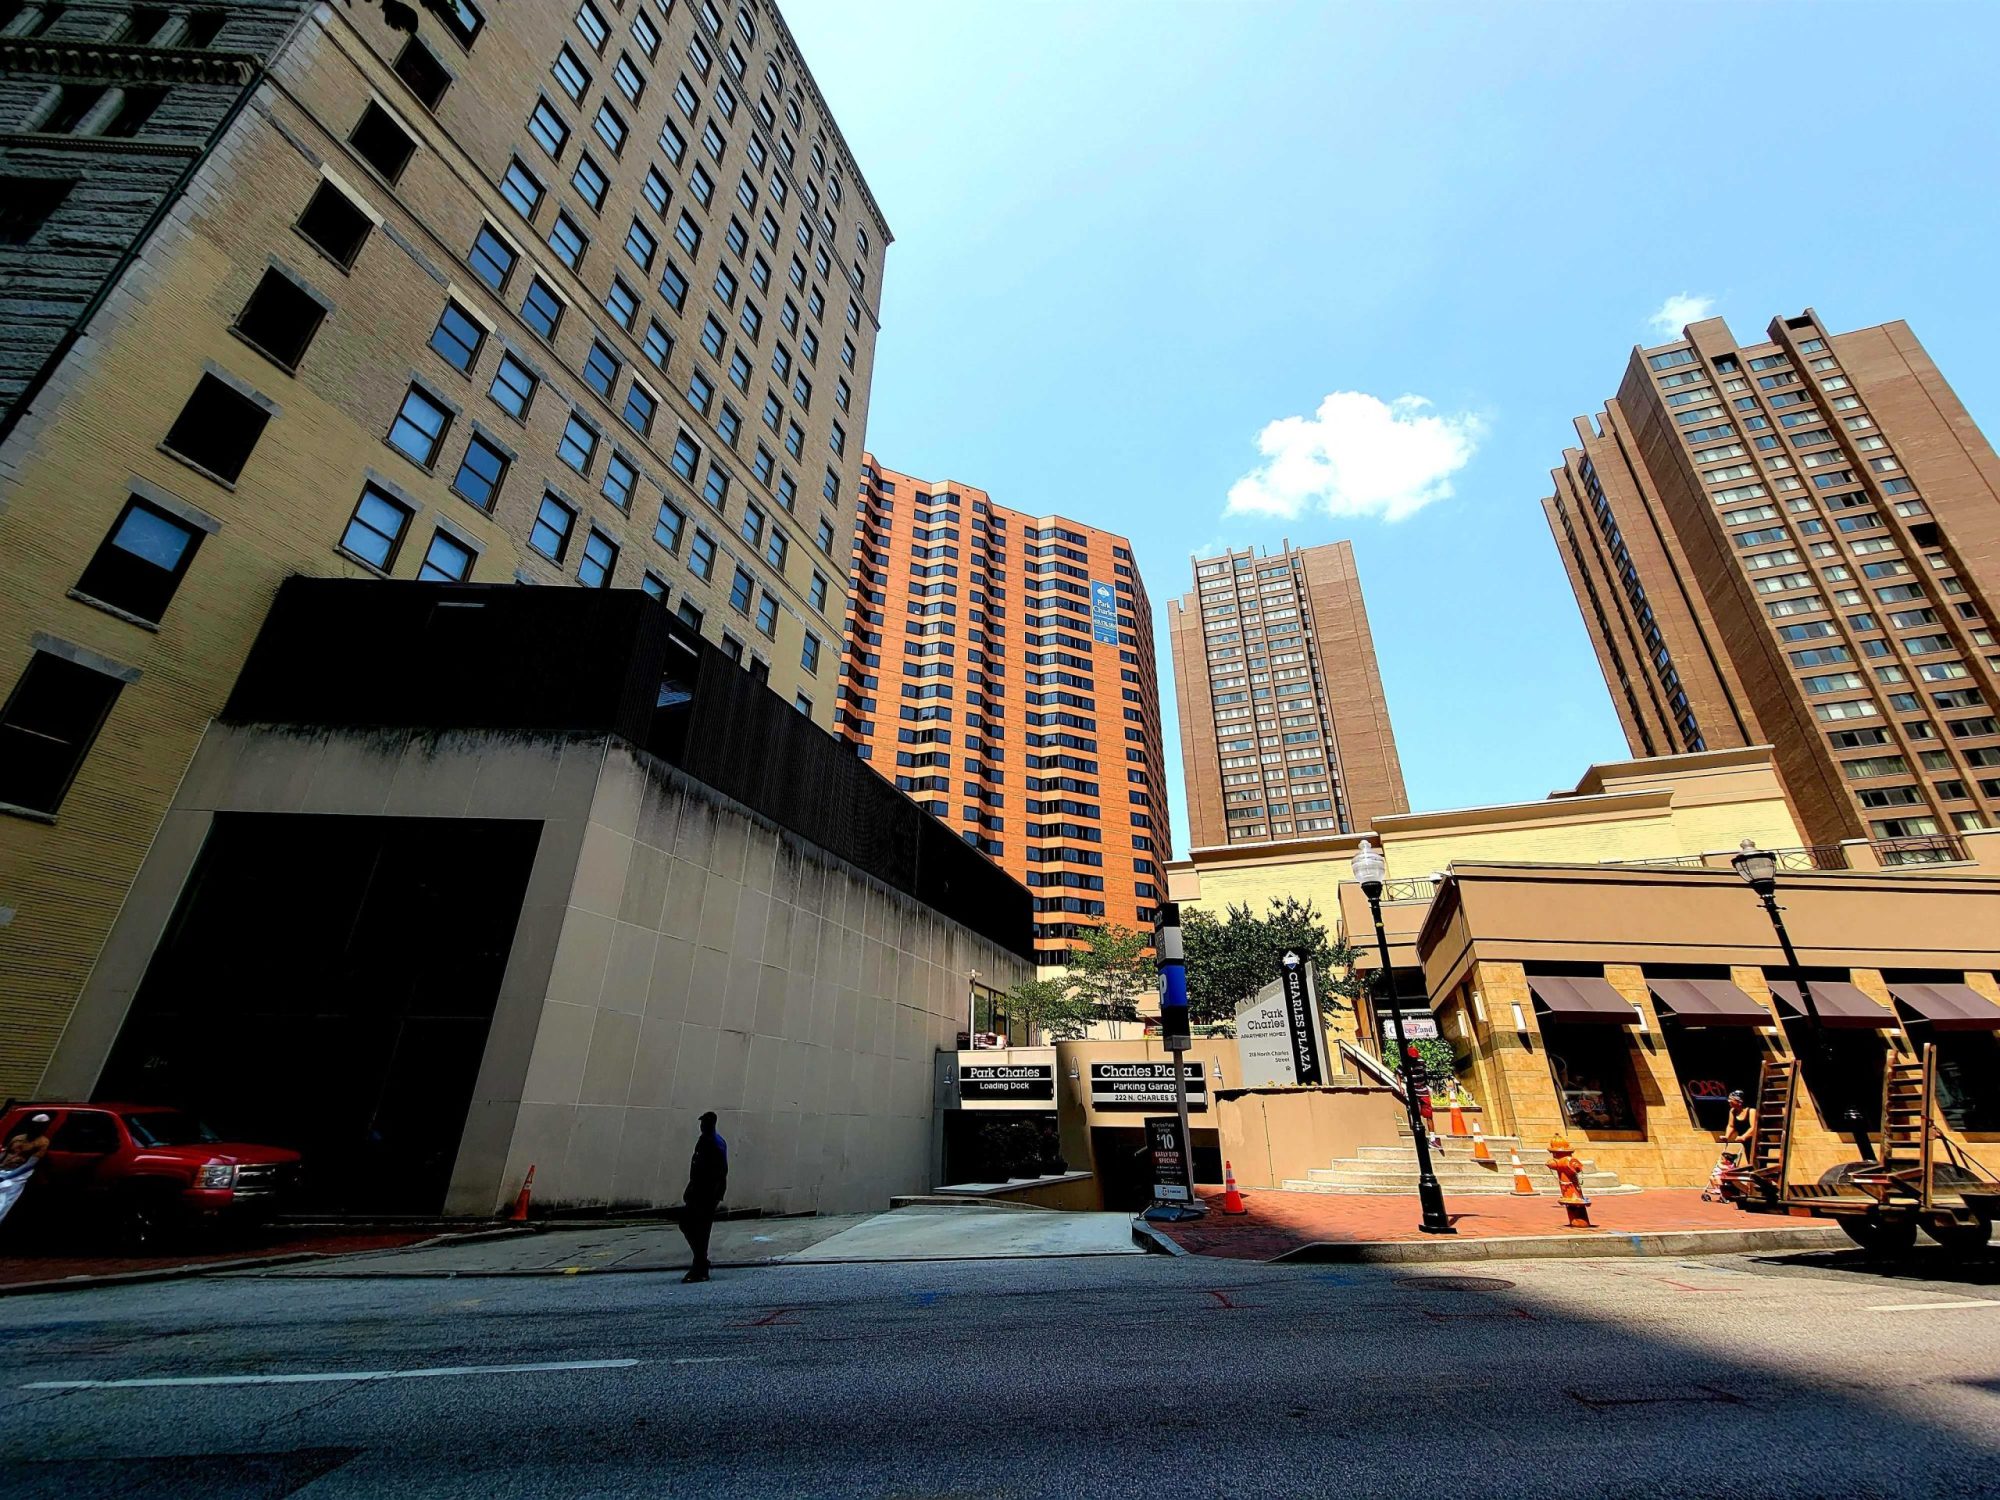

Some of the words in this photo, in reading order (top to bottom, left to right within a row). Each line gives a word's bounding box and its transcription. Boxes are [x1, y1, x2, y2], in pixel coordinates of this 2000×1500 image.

[1097, 599, 1111, 609] Park
[1093, 605, 1117, 617] Charles
[1159, 973, 1168, 1005] P
[1260, 1008, 1284, 1020] Park
[1247, 1019, 1285, 1030] Charles
[1289, 972, 1305, 1028] CHARLES
[1297, 1030, 1312, 1073] PLAZA
[970, 1067, 995, 1078] Park
[996, 1067, 1040, 1078] Charles
[1100, 1065, 1152, 1077] Charles
[1153, 1064, 1193, 1077] Plaa
[979, 1082, 1009, 1091] Loading
[1010, 1082, 1030, 1090] Dock
[1113, 1082, 1146, 1092] Parking
[1688, 1079, 1727, 1096] OPEN
